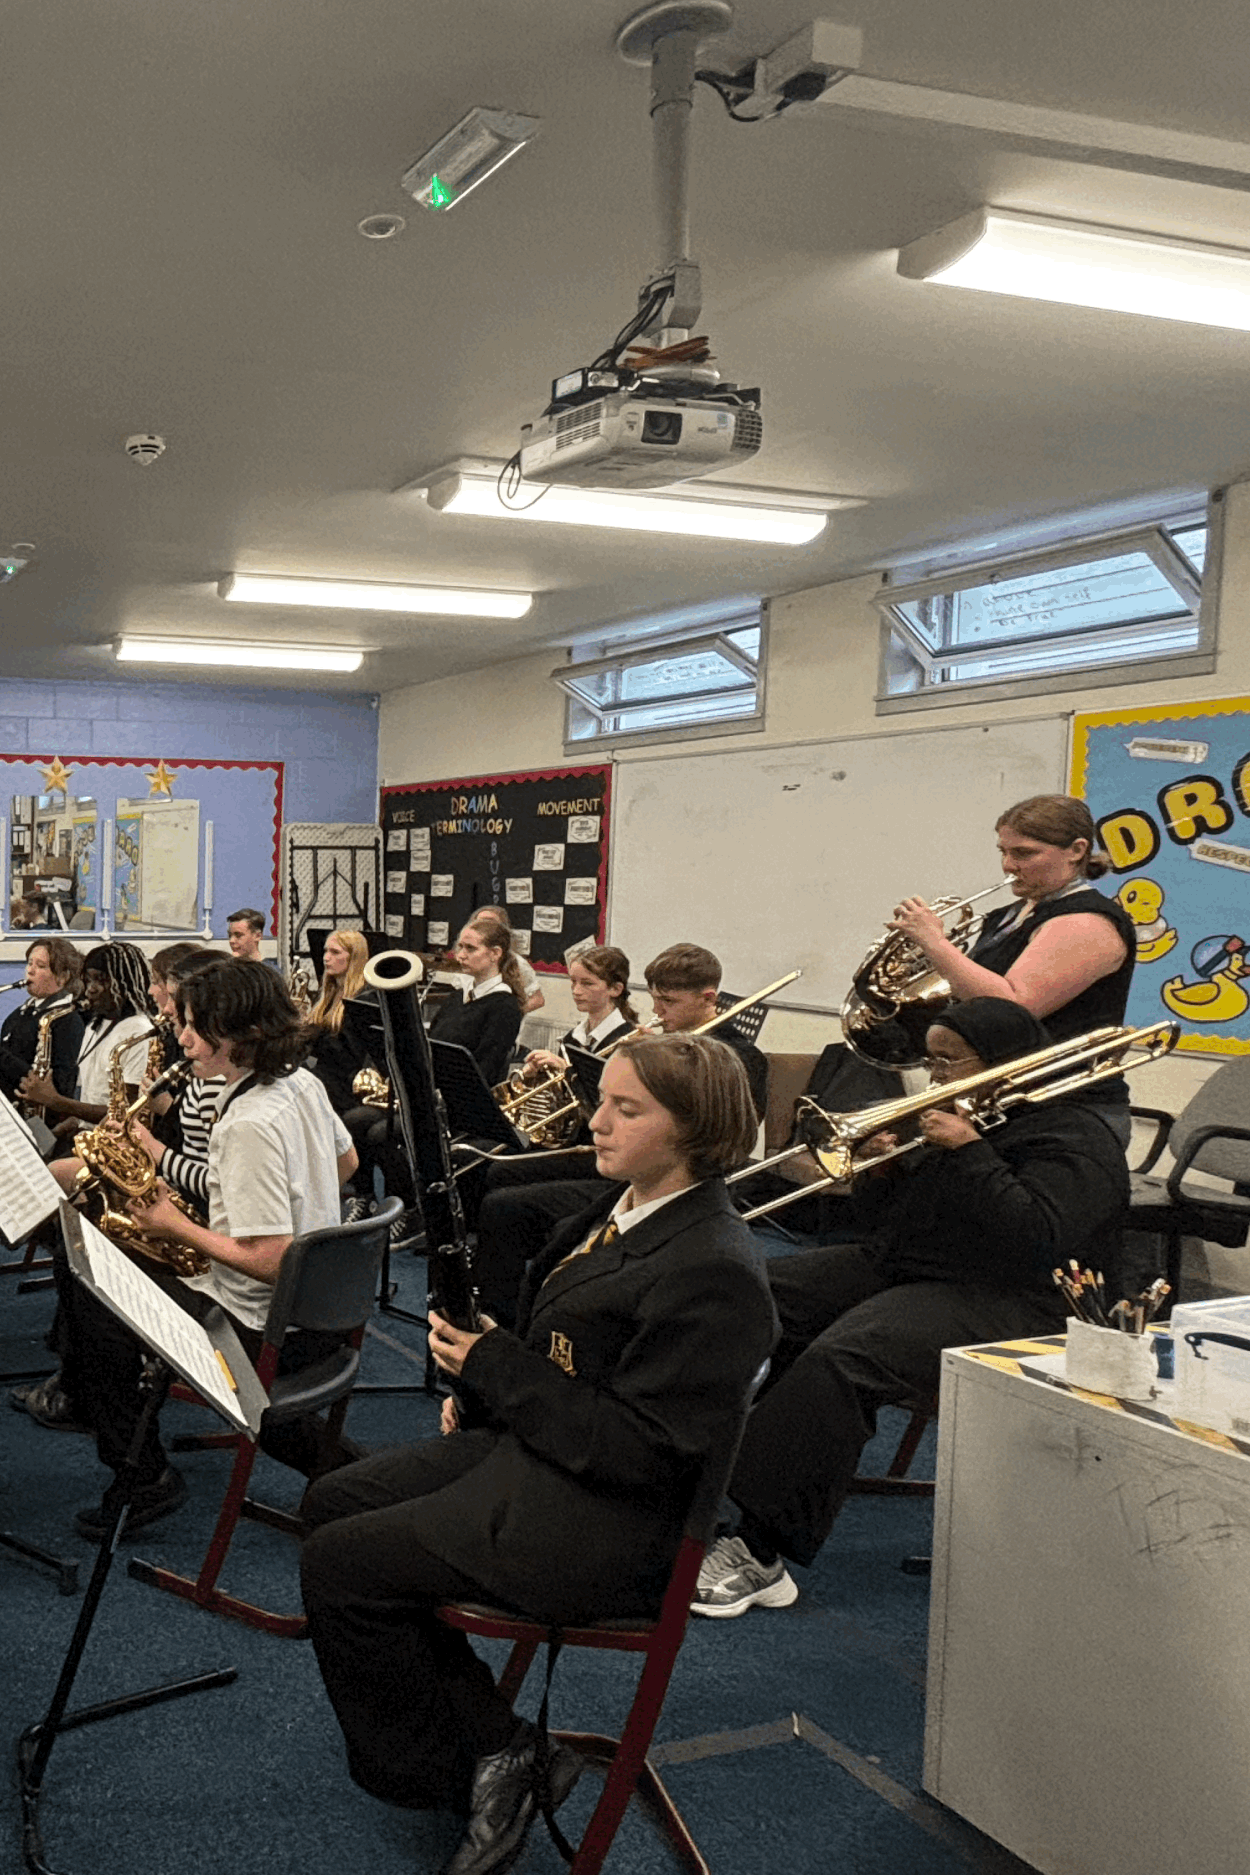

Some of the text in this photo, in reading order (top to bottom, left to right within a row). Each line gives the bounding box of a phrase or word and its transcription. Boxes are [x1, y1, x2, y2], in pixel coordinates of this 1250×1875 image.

[451, 793, 498, 816] DRAMA
[537, 798, 600, 816] MOVEMENT
[392, 809, 415, 823] VOICE
[432, 818, 512, 836] TERMINOLOGY
